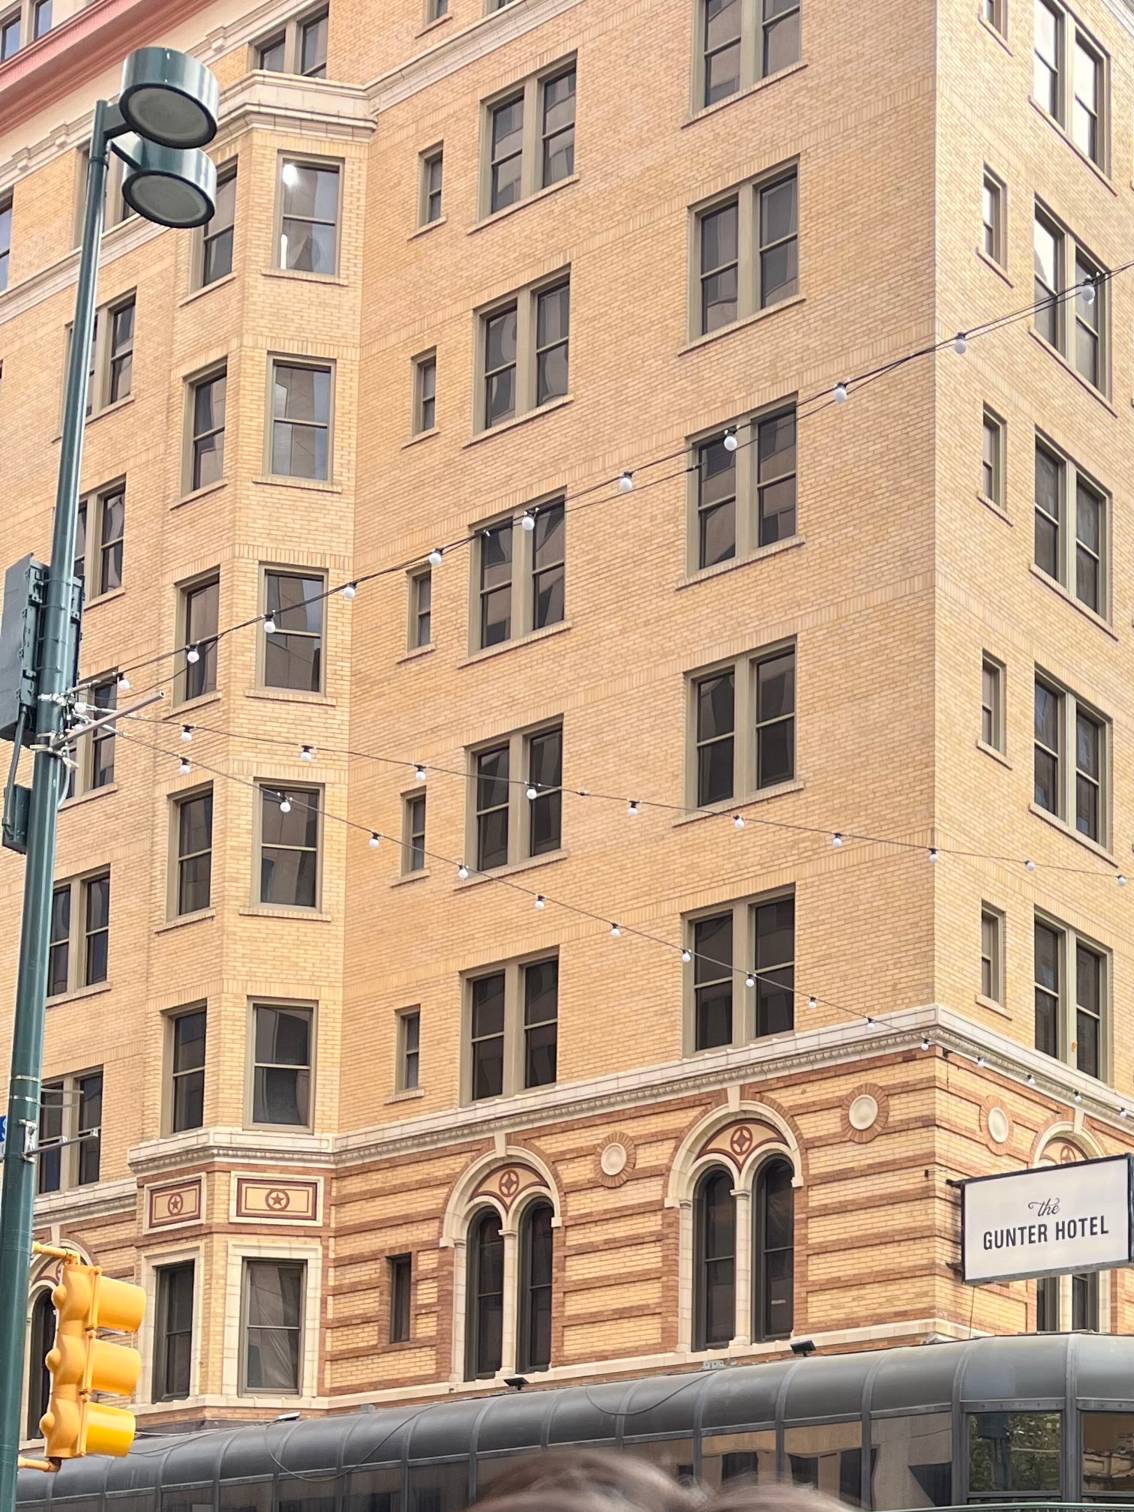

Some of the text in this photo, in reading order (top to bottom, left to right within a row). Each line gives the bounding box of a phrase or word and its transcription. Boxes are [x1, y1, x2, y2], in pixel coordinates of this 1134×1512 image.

[1028, 1197, 1061, 1217] the
[983, 1215, 1109, 1250] GUNTER HOTEL
